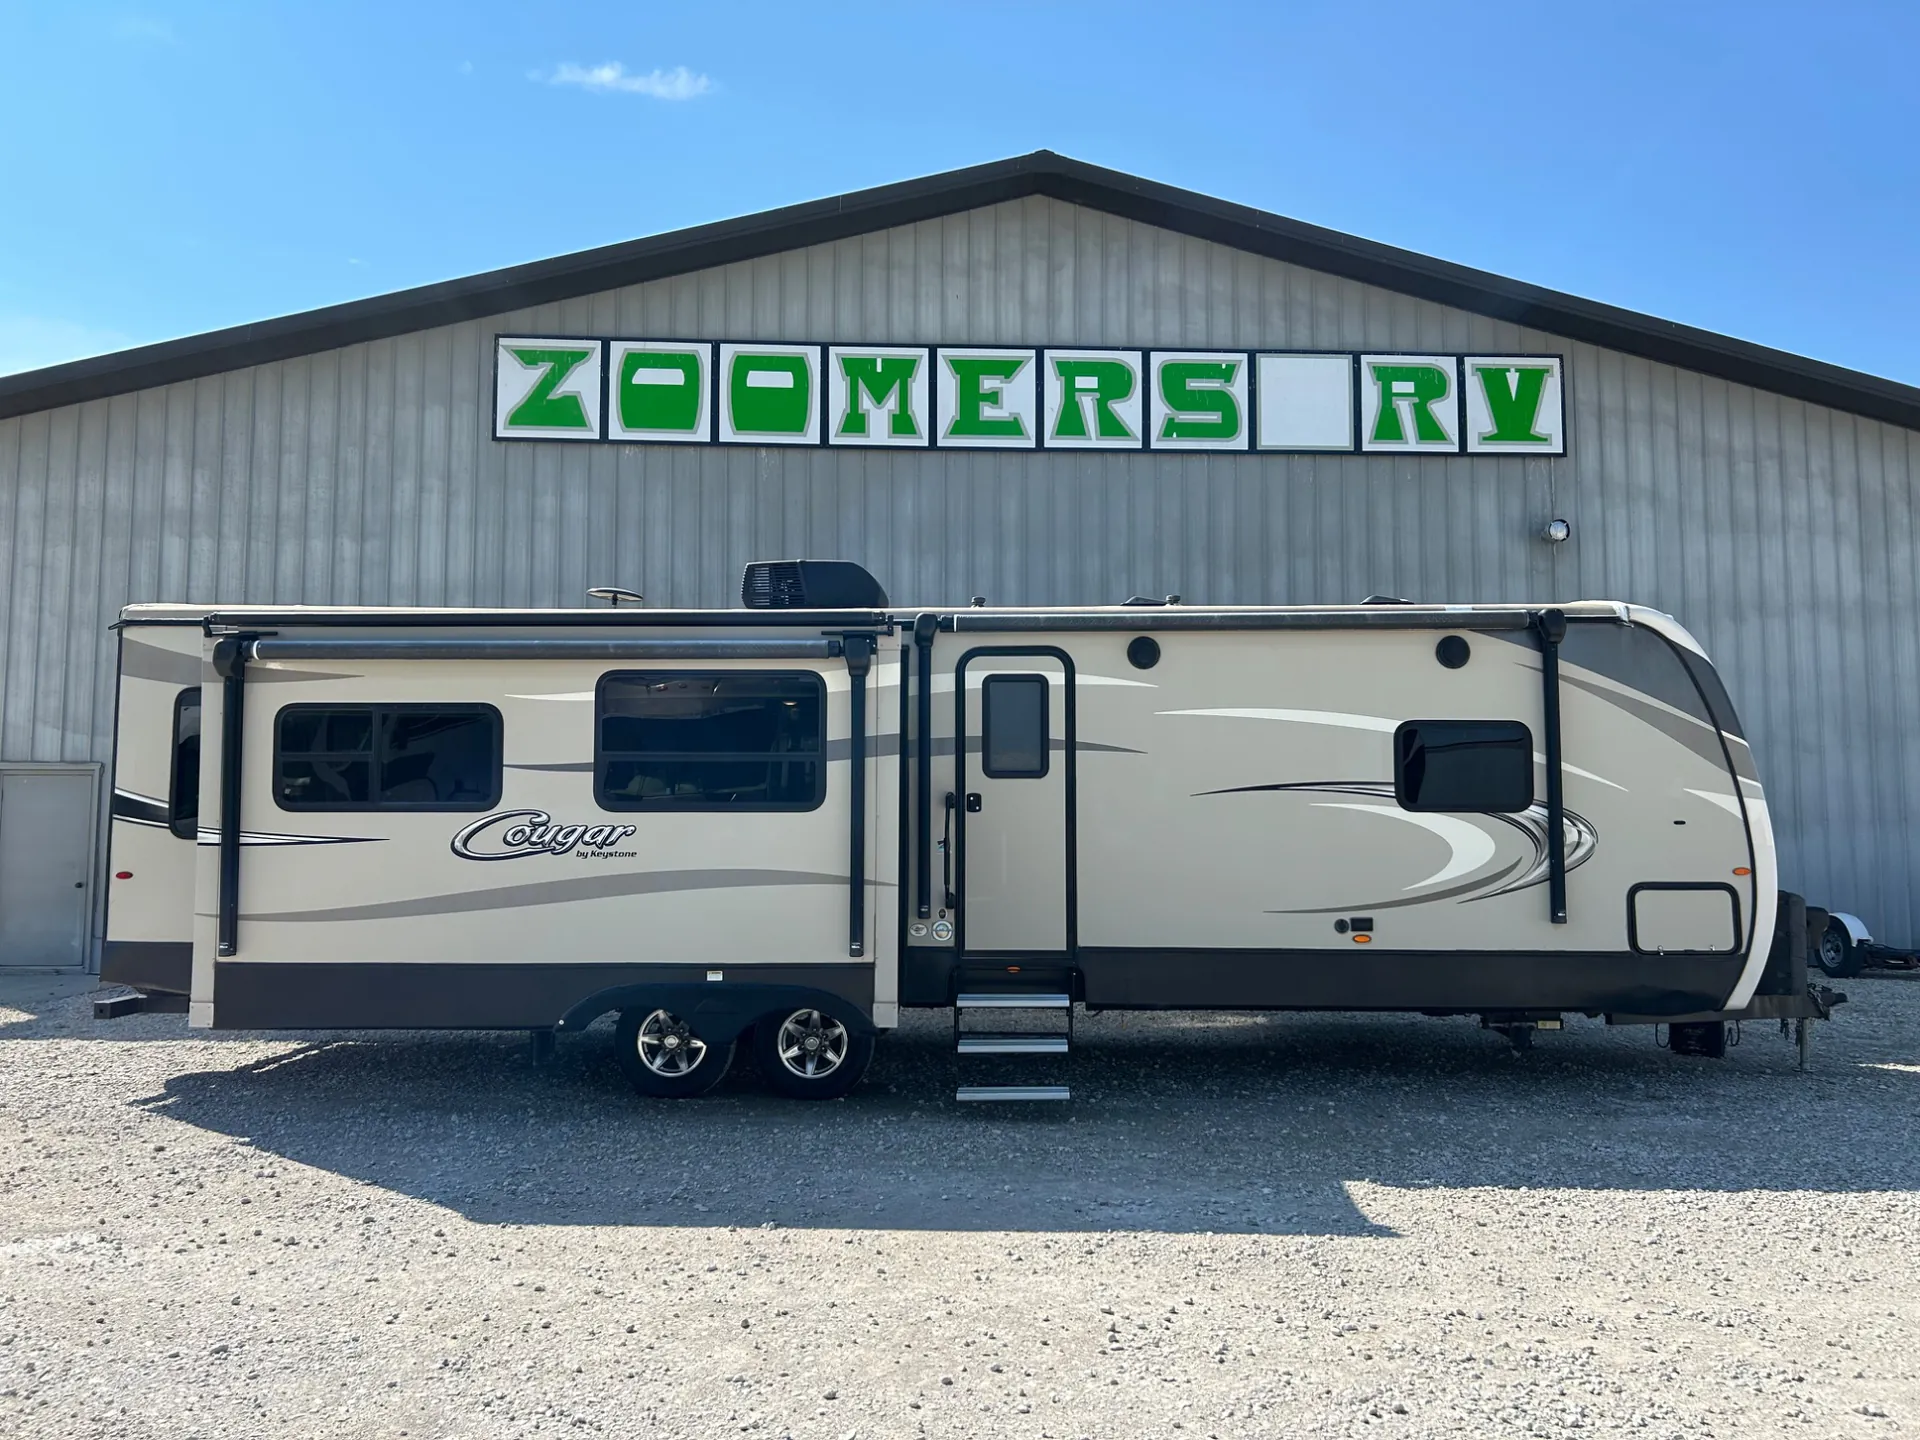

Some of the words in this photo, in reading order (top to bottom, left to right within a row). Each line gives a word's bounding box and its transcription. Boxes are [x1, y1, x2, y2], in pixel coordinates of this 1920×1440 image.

[498, 344, 1243, 442] ZOOMERS
[1367, 361, 1554, 446] RV
[450, 809, 637, 861] Cougar
[576, 850, 588, 859] by
[590, 850, 637, 859] Keystone
